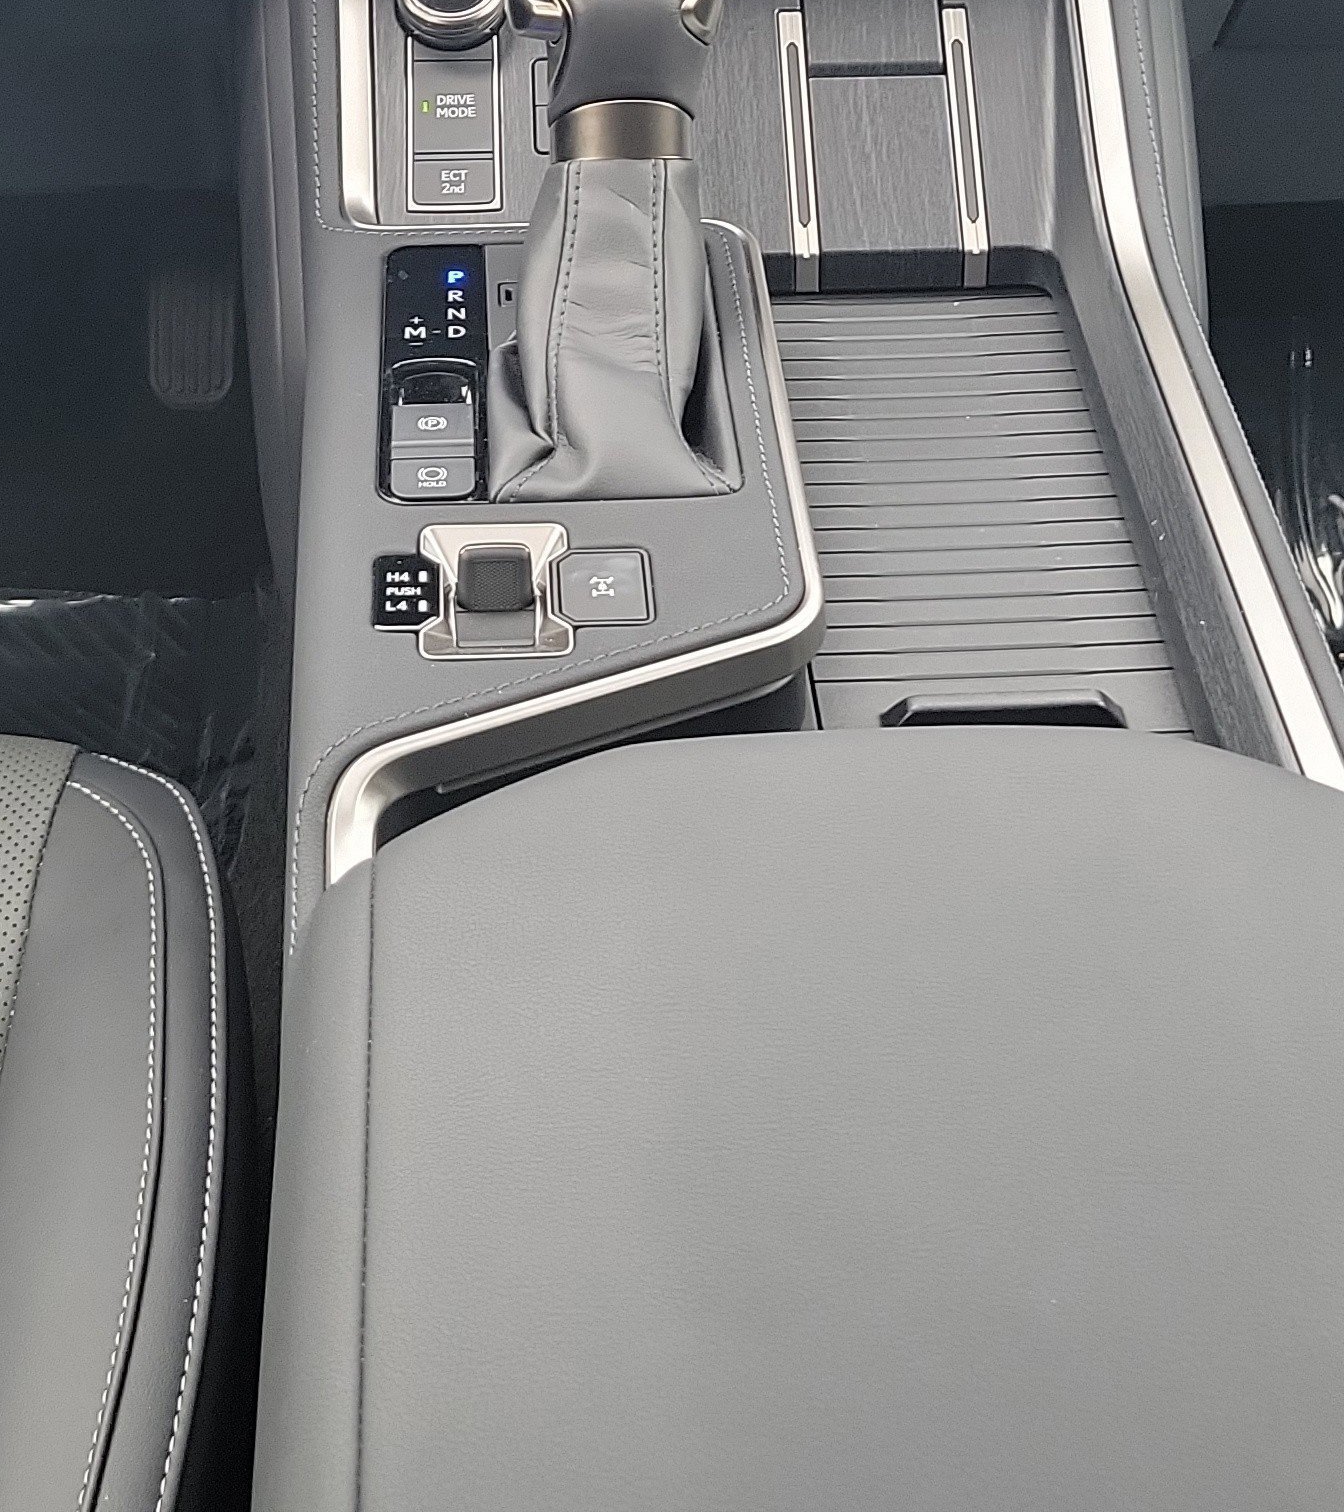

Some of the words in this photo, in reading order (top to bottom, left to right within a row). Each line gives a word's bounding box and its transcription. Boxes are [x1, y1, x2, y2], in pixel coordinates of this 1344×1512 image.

[436, 94, 475, 106] DRIVE
[436, 106, 477, 119] MODE
[440, 169, 468, 182] ECT
[440, 181, 466, 195] 2nd
[447, 270, 465, 284] P
[447, 290, 464, 303] R
[446, 306, 467, 321] N
[448, 324, 467, 339] D
[417, 480, 448, 489] HOLD
[386, 572, 411, 585] H4
[386, 585, 422, 596] PUSH
[385, 600, 408, 613] L4
